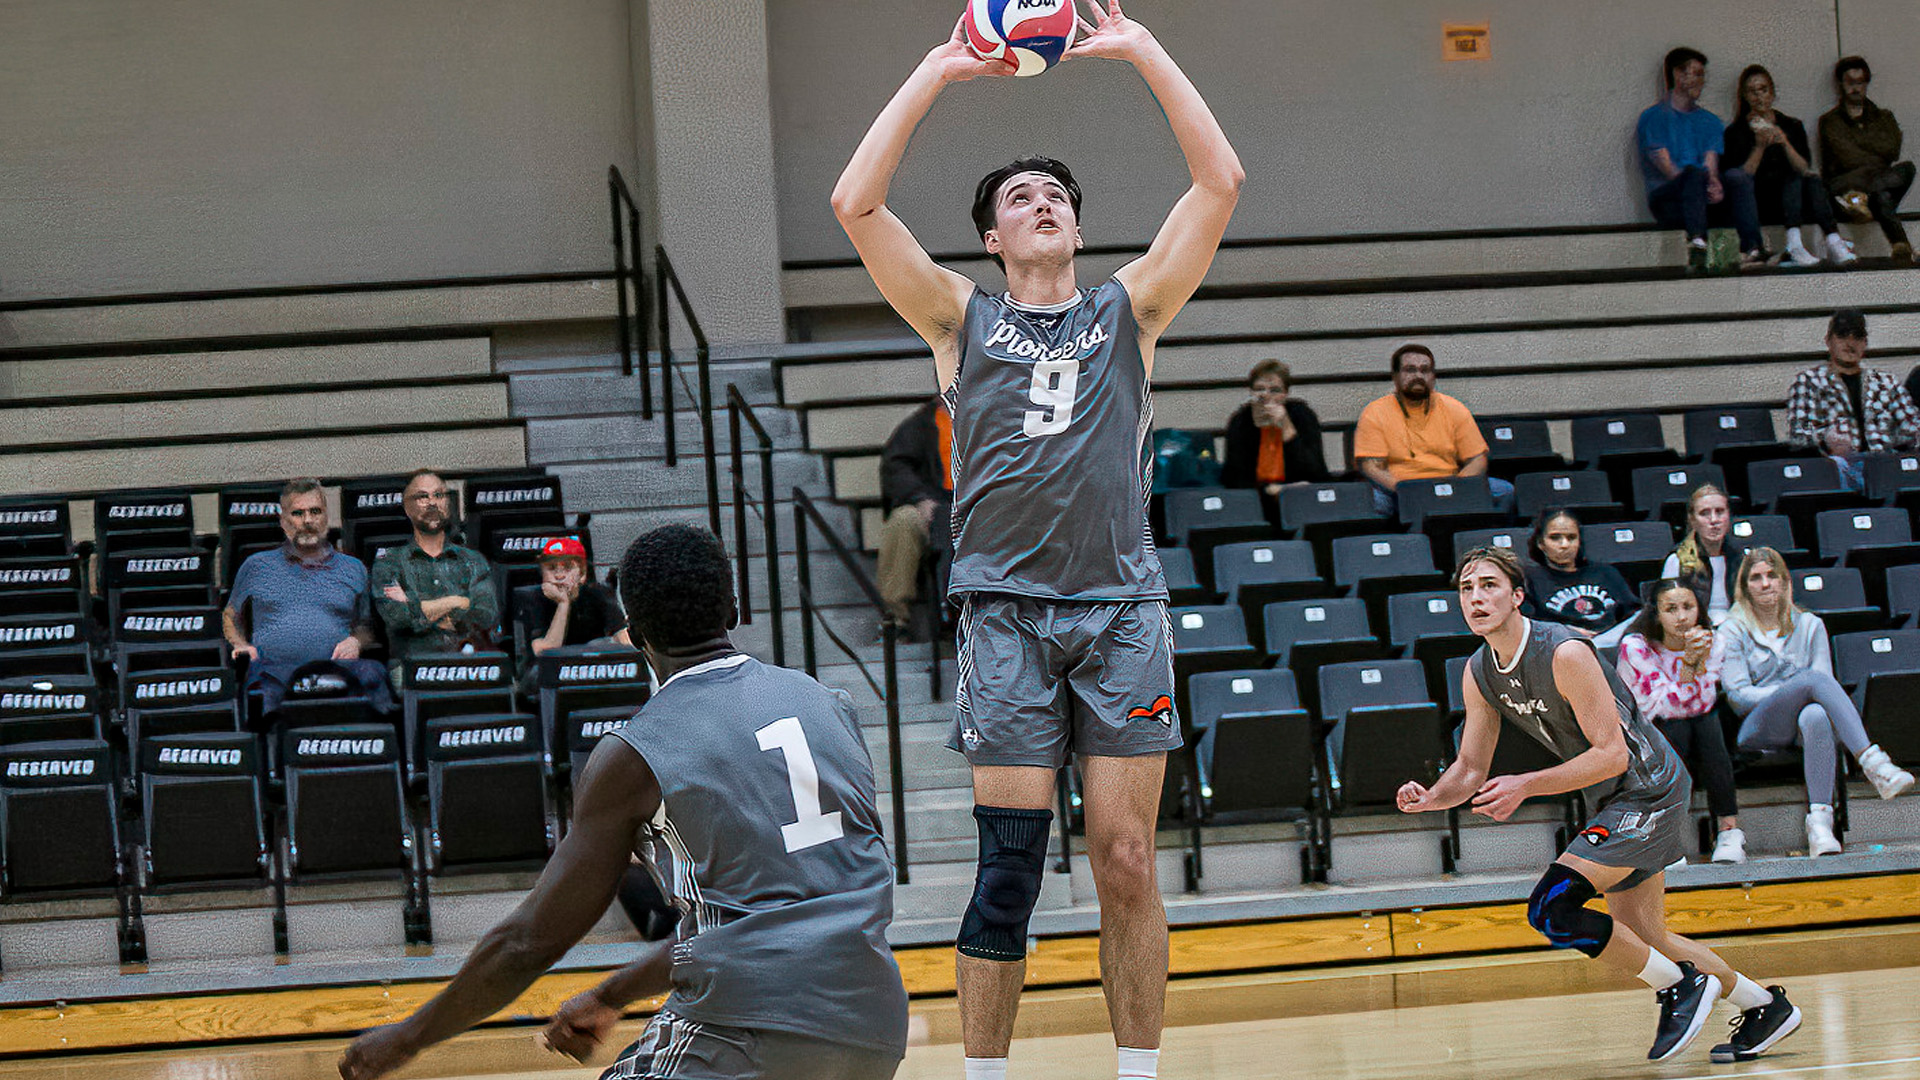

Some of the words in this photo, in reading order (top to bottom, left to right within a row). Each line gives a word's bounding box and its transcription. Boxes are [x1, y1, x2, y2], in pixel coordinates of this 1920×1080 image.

[985, 318, 1110, 361] Pioneers
[1023, 359, 1080, 438] 9
[357, 492, 403, 507] RESER
[475, 487, 554, 504] RESERVED
[229, 502, 283, 515] RESERV
[123, 616, 204, 632] RESERVED
[415, 665, 501, 682] RESERVED
[558, 662, 638, 681] RESERVED
[135, 677, 222, 699] RESERVED
[1, 693, 86, 710] RESERVED
[439, 725, 526, 748] RESERVED
[581, 720, 629, 738] RESE
[297, 738, 385, 755] RESERVED
[158, 747, 242, 766] RESERVED
[6, 759, 95, 777] RESERVED
[754, 716, 845, 854] 1
